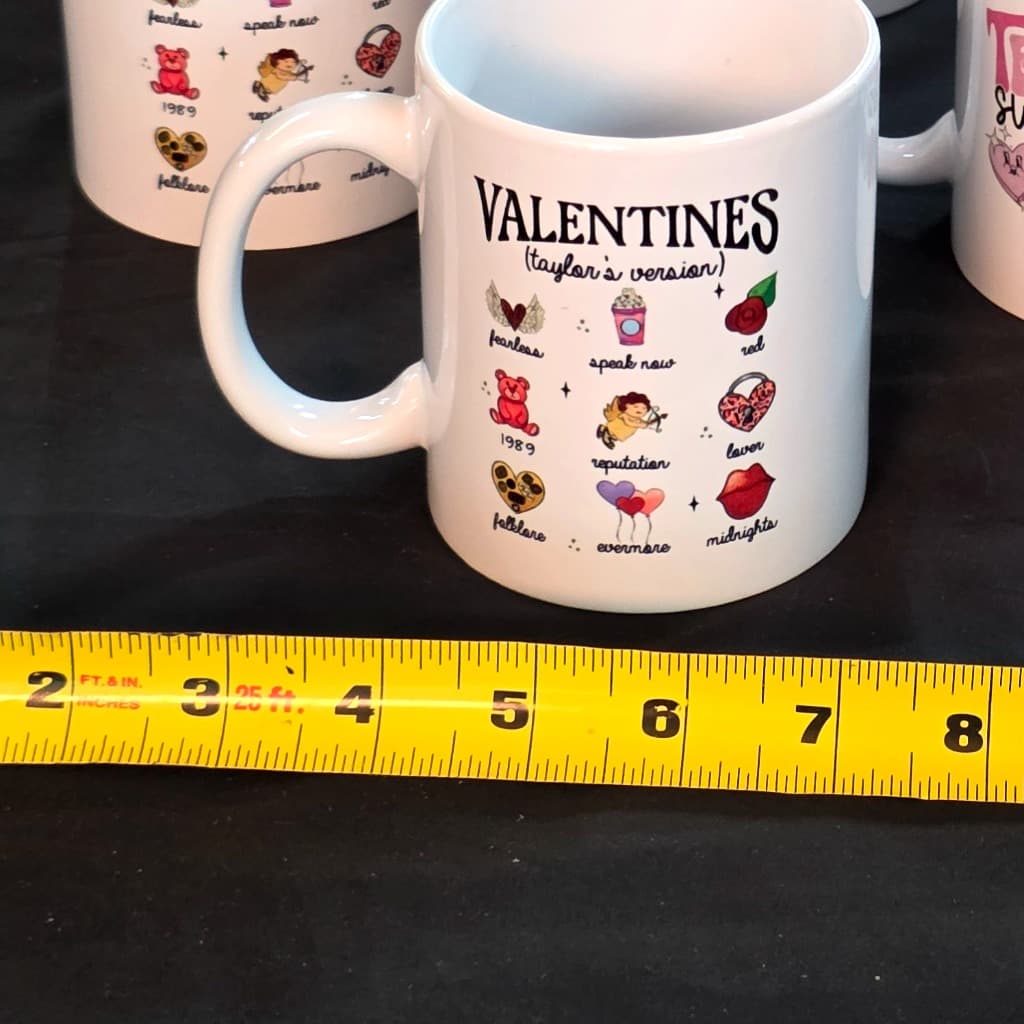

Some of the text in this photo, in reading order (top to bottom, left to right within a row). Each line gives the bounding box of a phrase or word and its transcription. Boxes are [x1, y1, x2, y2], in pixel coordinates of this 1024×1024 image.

[147, 9, 203, 29] fearless
[289, 15, 320, 28] now
[160, 101, 198, 118] 1989
[157, 174, 210, 194] folklore
[474, 175, 779, 255] VALENTINES
[524, 246, 726, 283] (taylor's version)
[488, 329, 545, 358] fearless
[741, 335, 765, 357] red
[588, 354, 677, 375] speak now
[500, 432, 536, 456] 1989
[726, 439, 765, 460] lover
[591, 456, 670, 475] reputation
[492, 512, 547, 543] folklore
[706, 517, 778, 548] midnights
[596, 540, 671, 555] evermore
[25, 670, 69, 710] 2
[181, 677, 221, 717] 3
[233, 684, 263, 713] 25
[333, 684, 375, 724] 4
[489, 689, 530, 731] 5
[641, 698, 681, 739] 6
[795, 705, 833, 744] 7
[943, 713, 984, 753] 8
